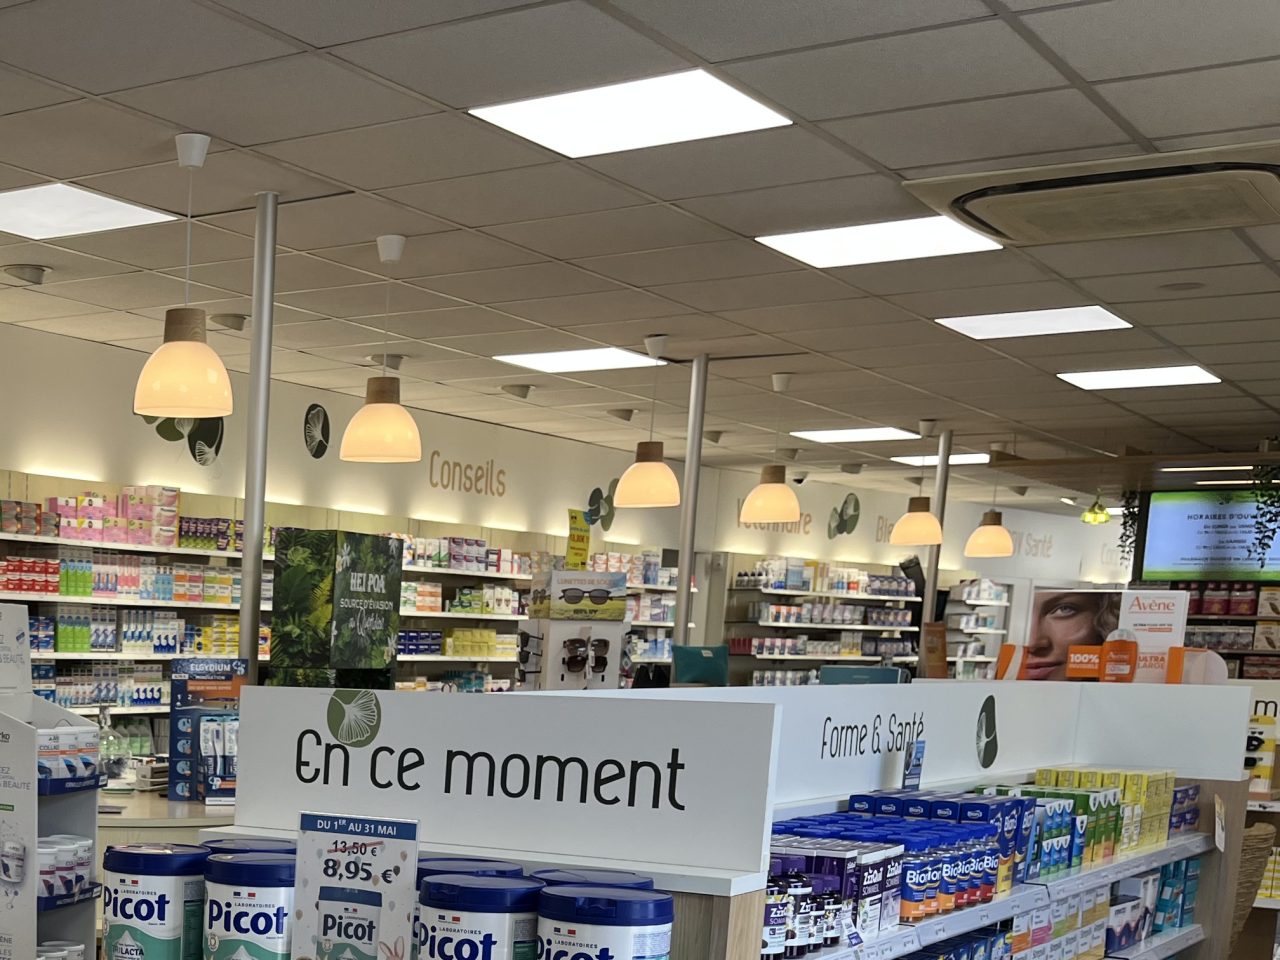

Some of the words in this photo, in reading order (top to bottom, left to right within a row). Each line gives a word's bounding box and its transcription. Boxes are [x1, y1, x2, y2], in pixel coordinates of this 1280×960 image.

[429, 449, 507, 497] Conseils
[1128, 595, 1175, 611] Avène
[190, 663, 231, 672] ELGYDIUM
[1069, 653, 1099, 663] 100%
[821, 716, 868, 760] Forme
[887, 711, 924, 753] Santé
[296, 728, 350, 787] En
[369, 746, 425, 791] ce
[444, 747, 686, 811] moment
[317, 819, 331, 829] DU
[348, 823, 362, 834] AU
[364, 824, 375, 834] 31
[377, 825, 397, 836] MAI
[332, 840, 367, 857] 13,50
[323, 858, 373, 882] 8,95
[381, 869, 393, 884] €
[208, 899, 289, 935] Picot
[322, 913, 377, 942] Picot
